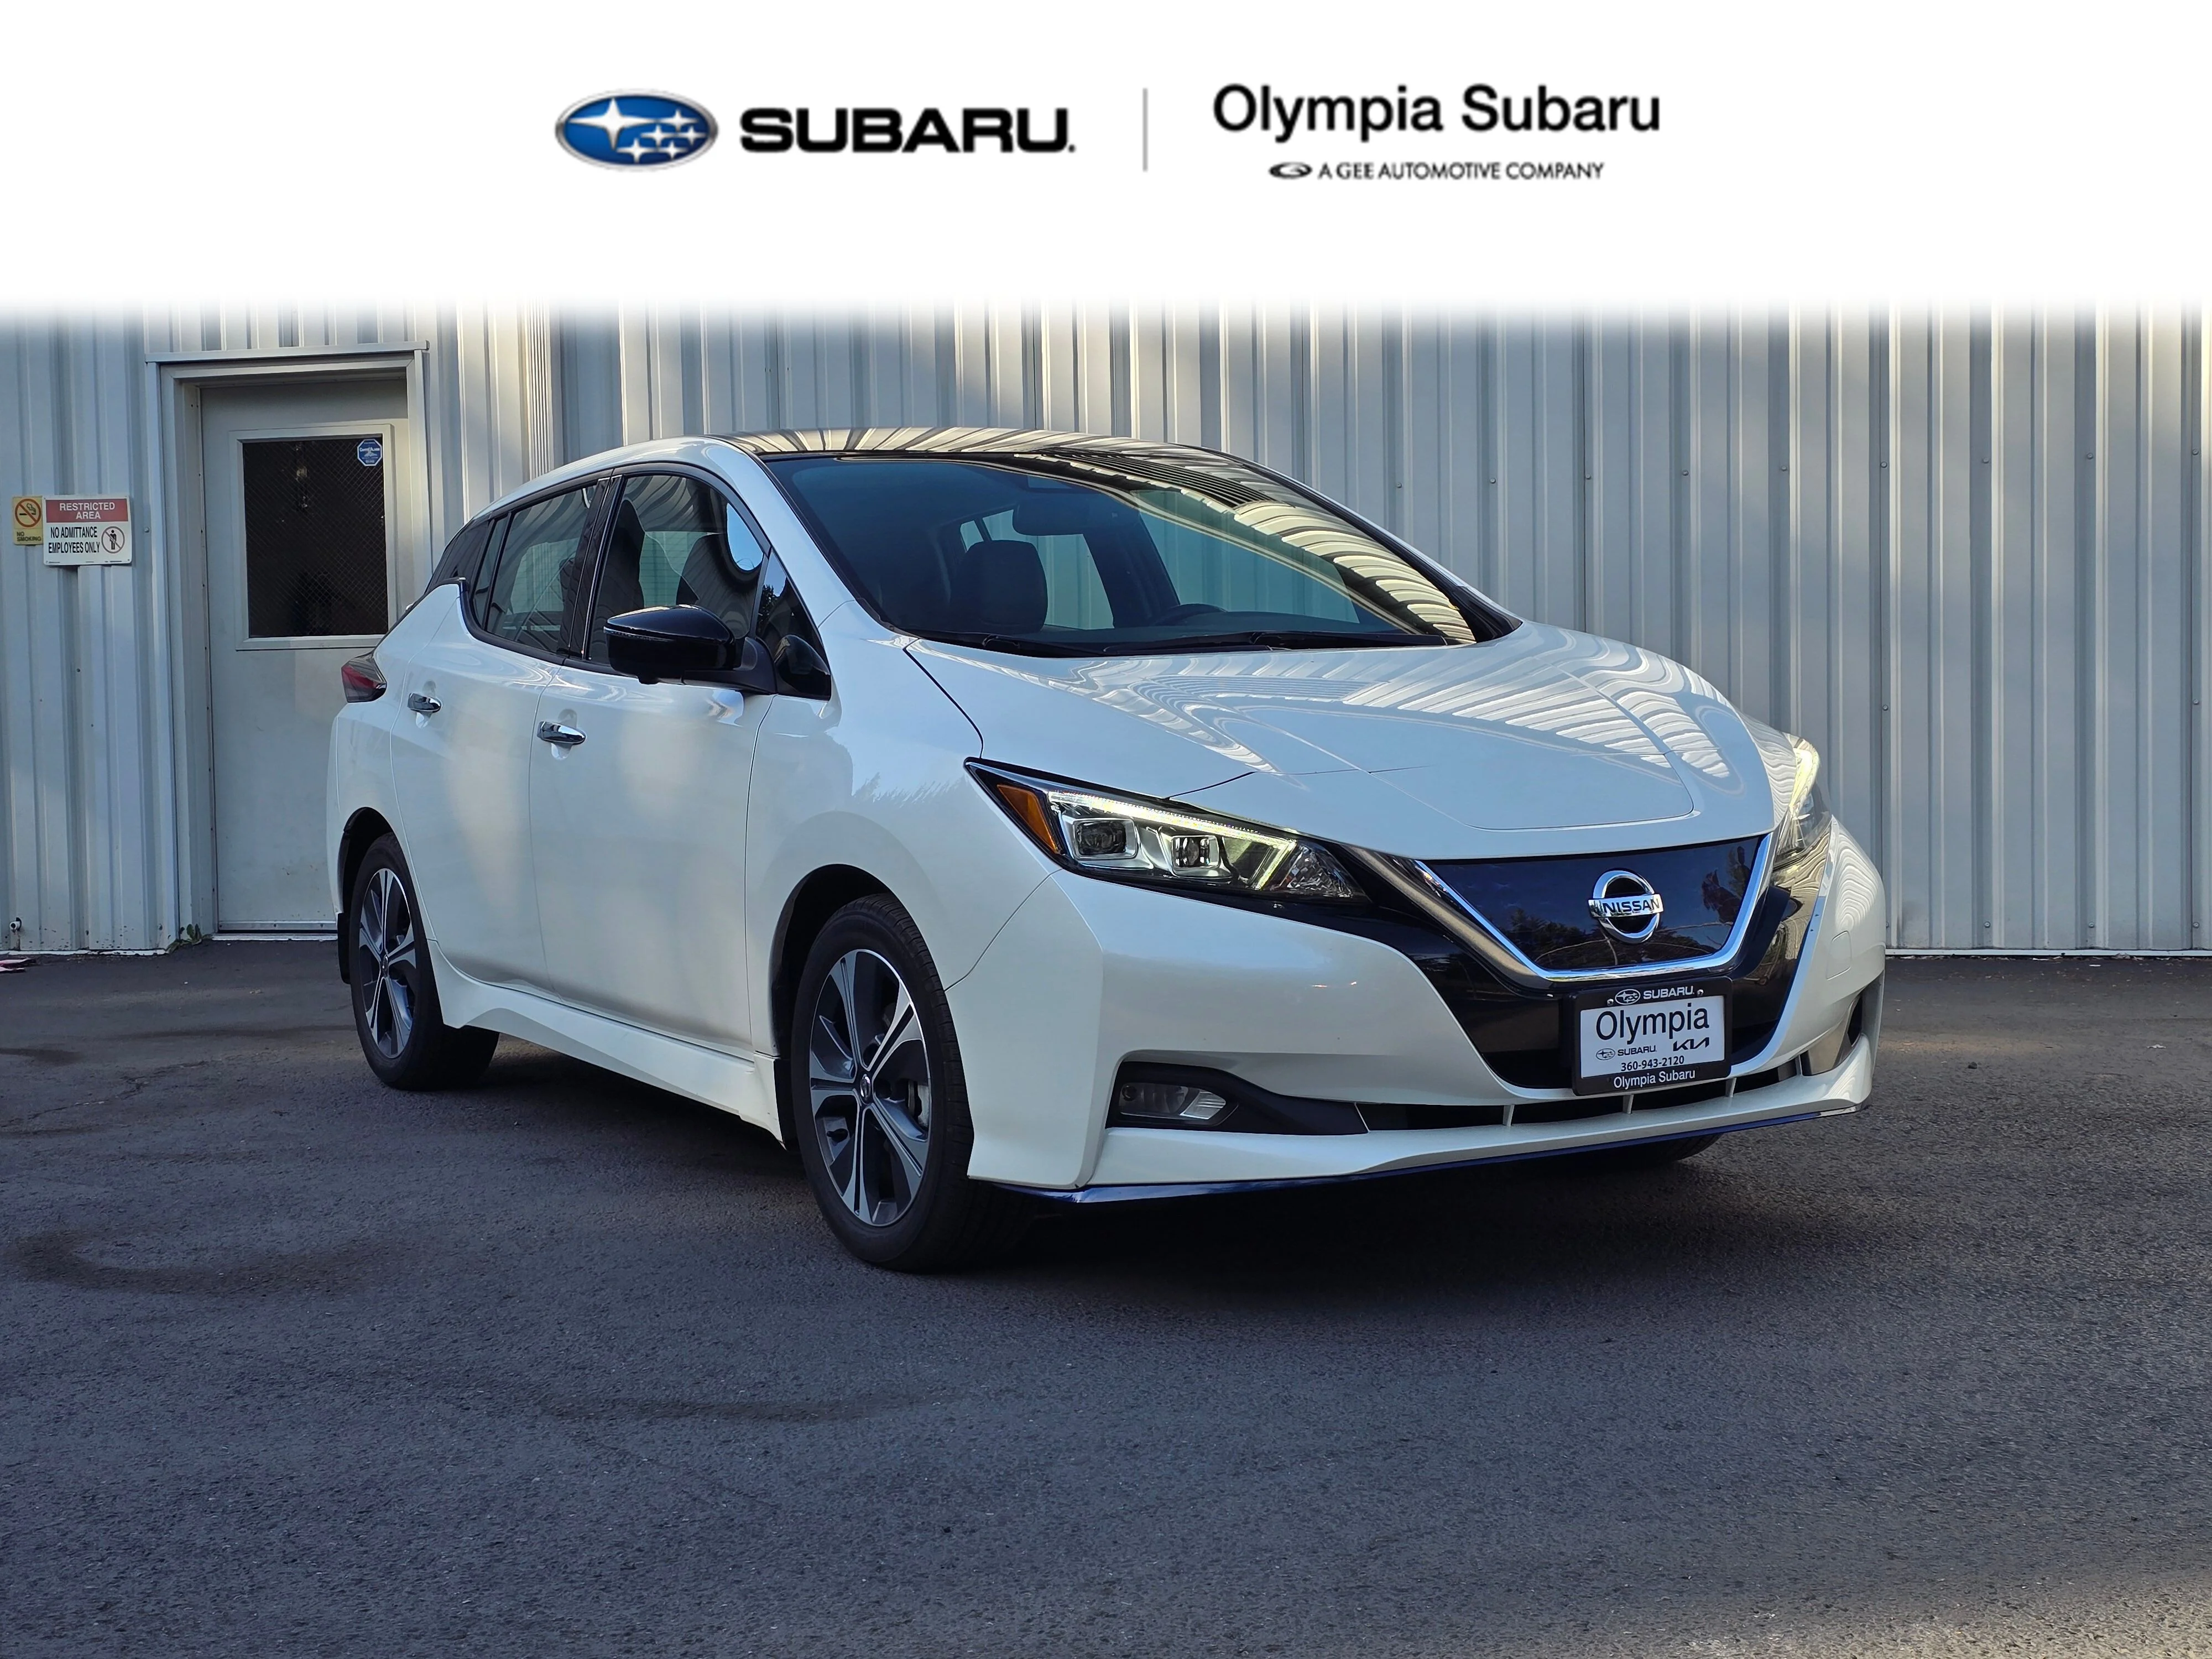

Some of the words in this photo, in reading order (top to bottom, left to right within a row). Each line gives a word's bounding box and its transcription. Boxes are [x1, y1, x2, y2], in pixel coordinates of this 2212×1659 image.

[59, 502, 115, 511] RESTRICTED
[76, 511, 101, 519] AREA
[50, 526, 59, 538] NO
[60, 526, 98, 538] ADMITTANCE
[49, 542, 84, 554] EMPLOYEES
[85, 541, 100, 553] ONLY
[1603, 899, 1659, 913] NISSAN
[1643, 986, 1693, 1000] SUBARU
[1596, 1003, 1709, 1045] Olympia
[1618, 1046, 1656, 1056] SUBARU
[1621, 1055, 1684, 1072] 360-943-2120
[1614, 1073, 1656, 1089] Olympia
[1658, 1069, 1695, 1082] Subaru
